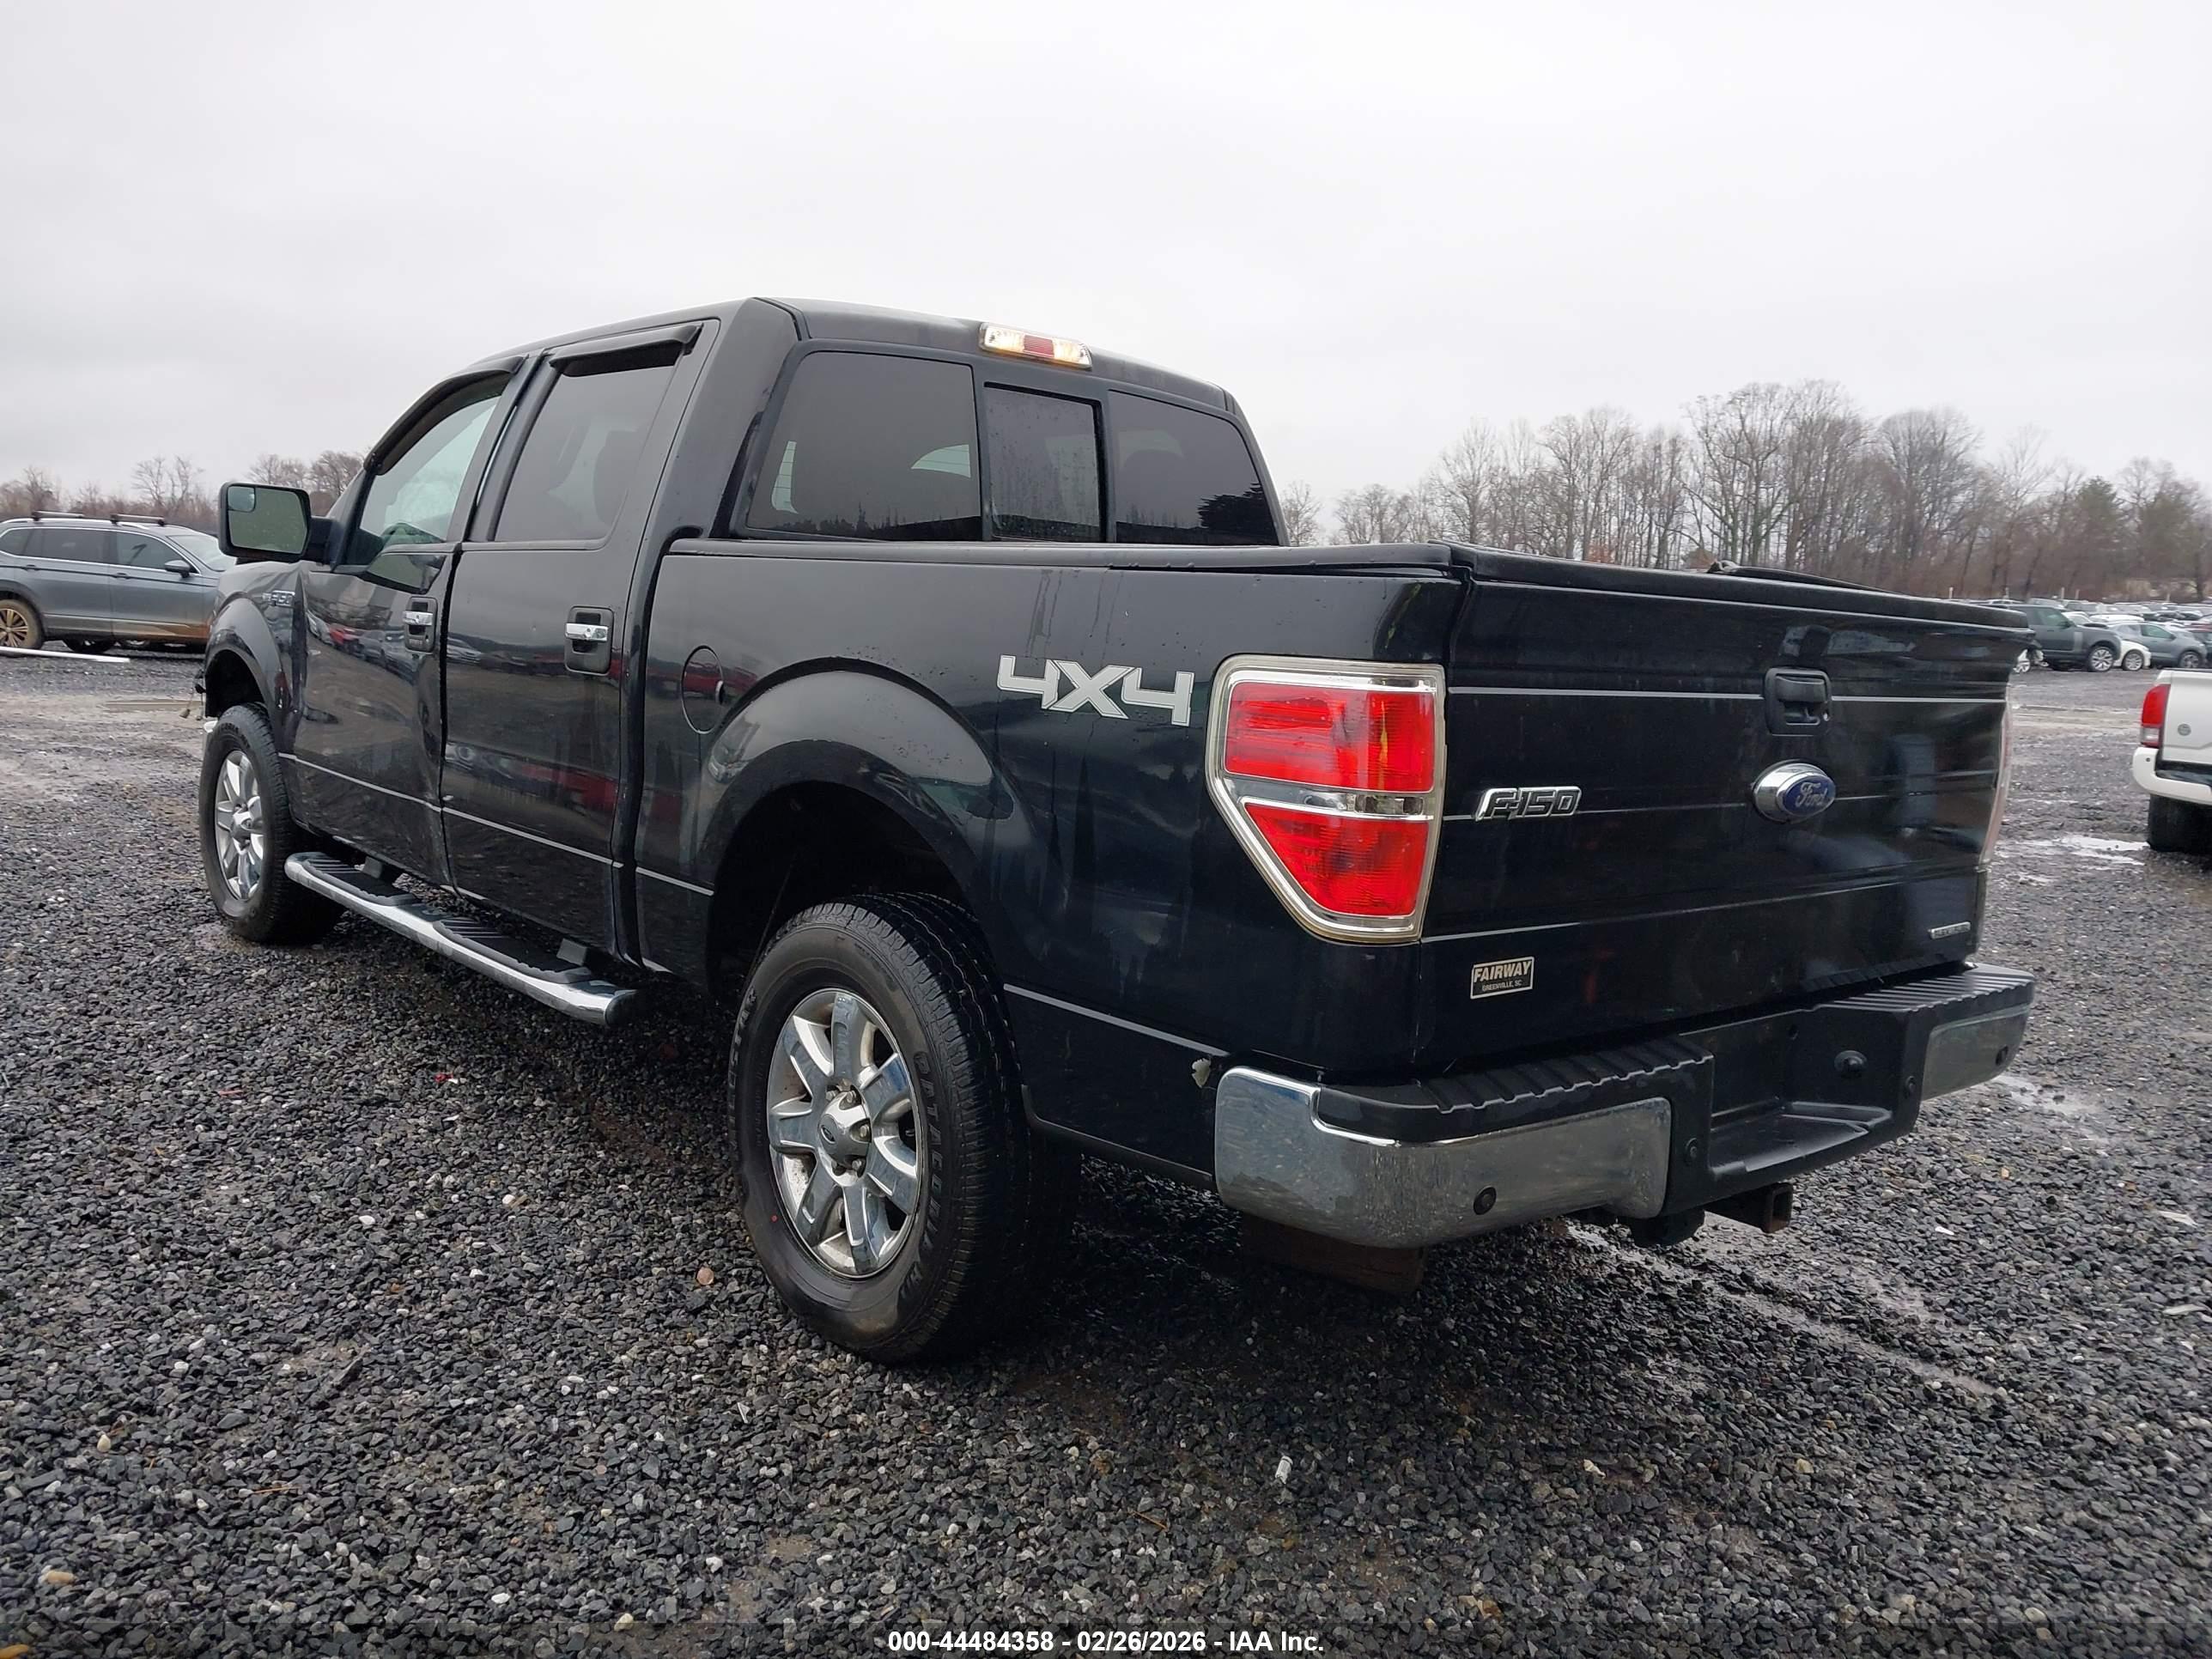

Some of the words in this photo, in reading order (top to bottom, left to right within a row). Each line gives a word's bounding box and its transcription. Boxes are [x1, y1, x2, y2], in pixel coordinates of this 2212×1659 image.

[1475, 786, 1583, 822] F-150
[1795, 781, 1828, 808] Ford
[1474, 961, 1532, 983] FAIRWAY
